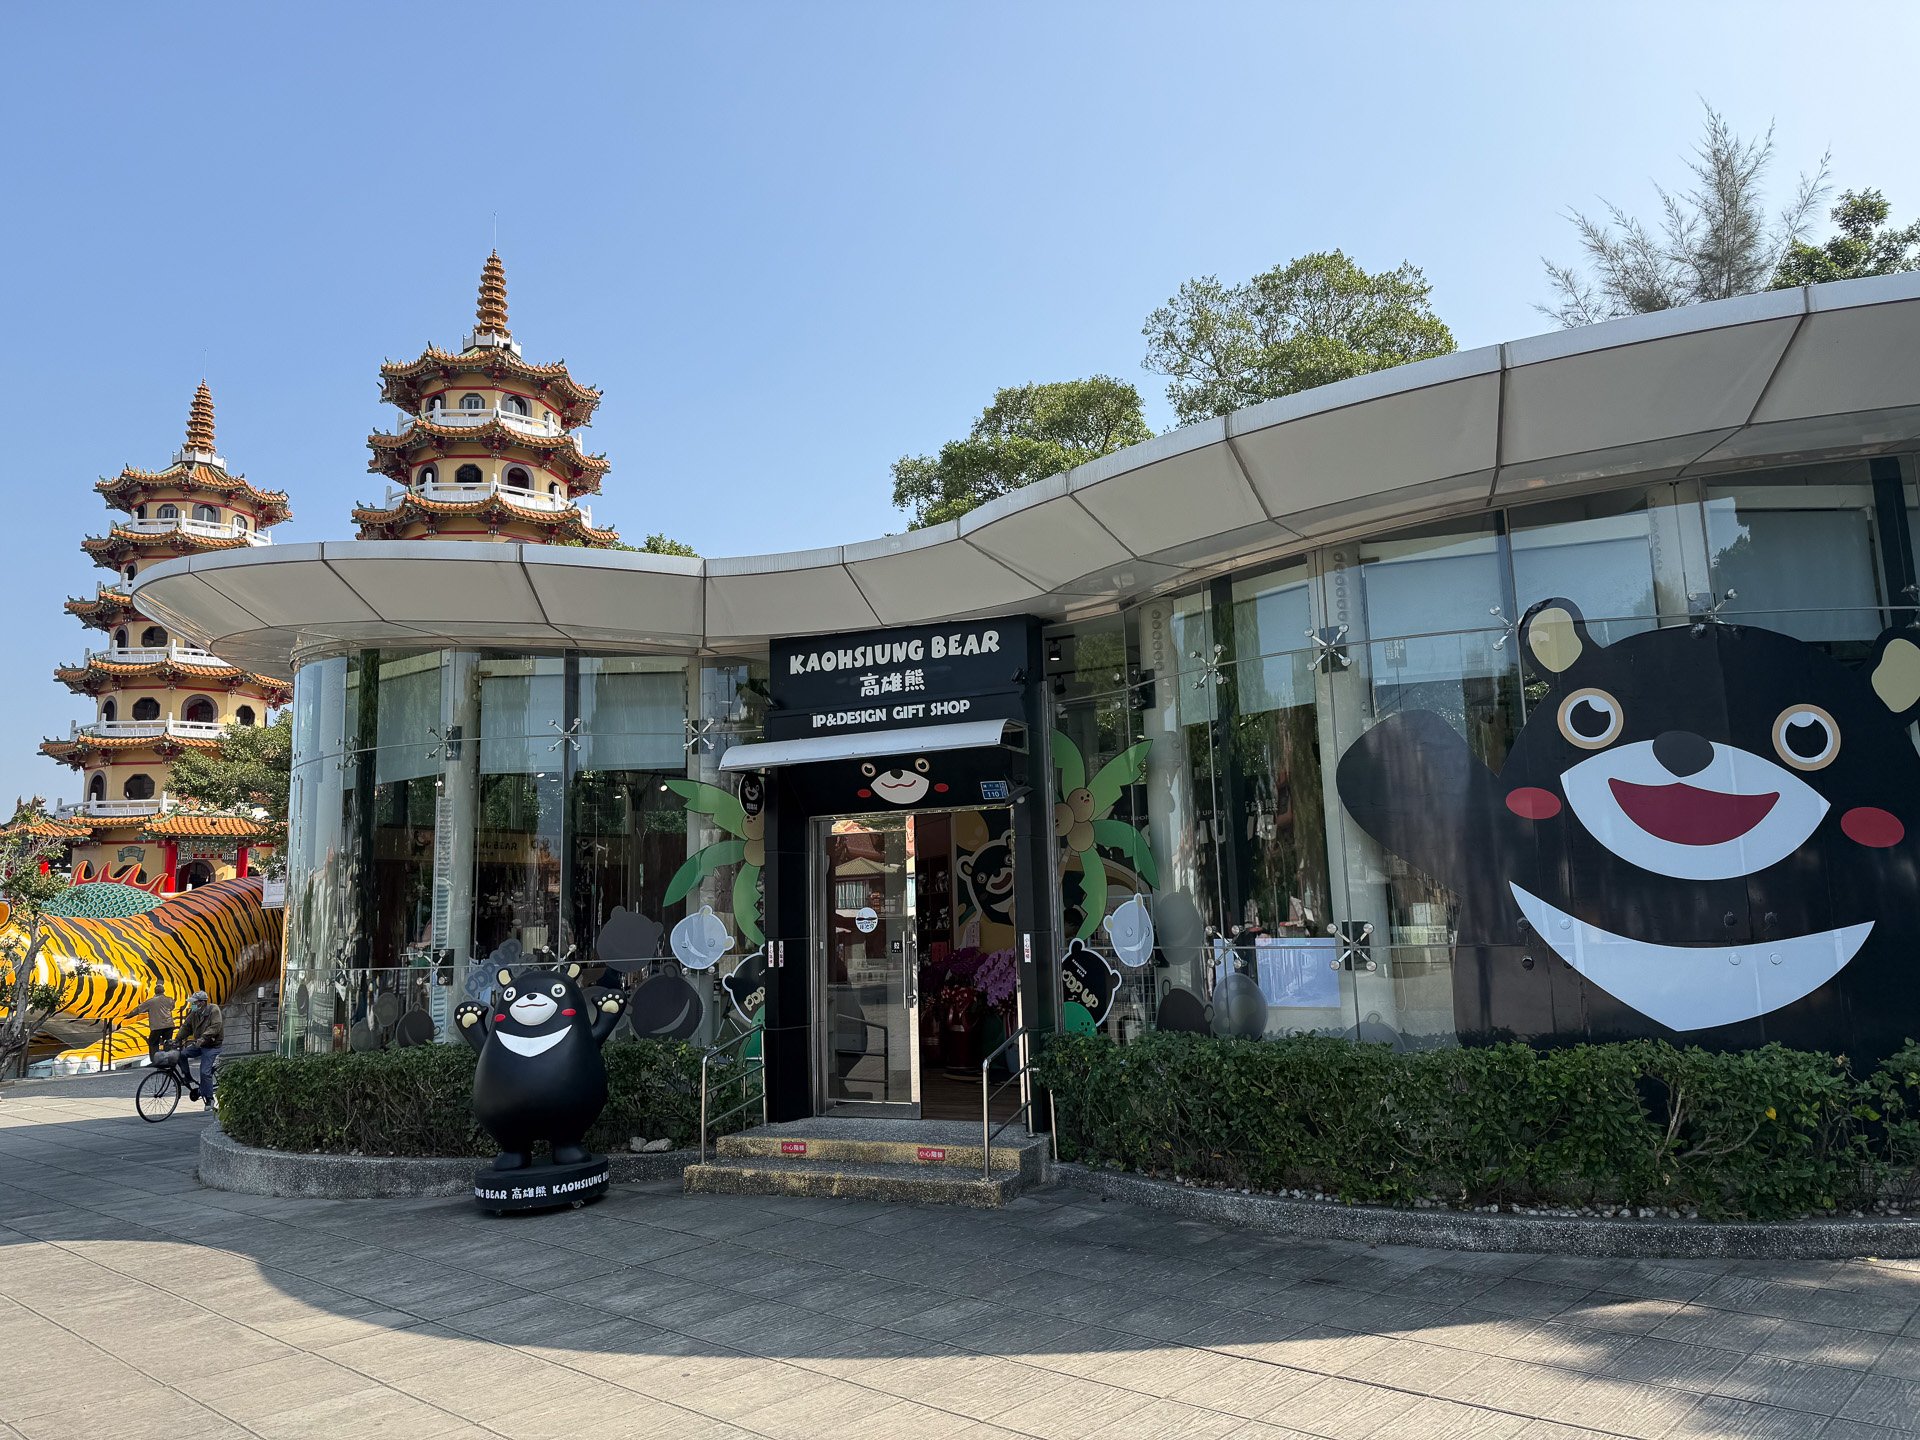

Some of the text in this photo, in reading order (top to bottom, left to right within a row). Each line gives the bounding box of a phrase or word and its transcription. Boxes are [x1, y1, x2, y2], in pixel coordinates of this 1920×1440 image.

[790, 630, 1000, 674] KAOHSIUNG BEAR
[860, 668, 925, 697] 高雄熊
[812, 699, 970, 728] IP&DESIGN GIFT SHOP
[1081, 988, 1099, 1008] UP
[782, 1144, 805, 1152] 小心階梯
[919, 1150, 944, 1159] 小心階梯
[511, 1185, 547, 1200] 高雄熊
[552, 1173, 602, 1195] KAOHSIUNG
[485, 1189, 508, 1200] BEAR
